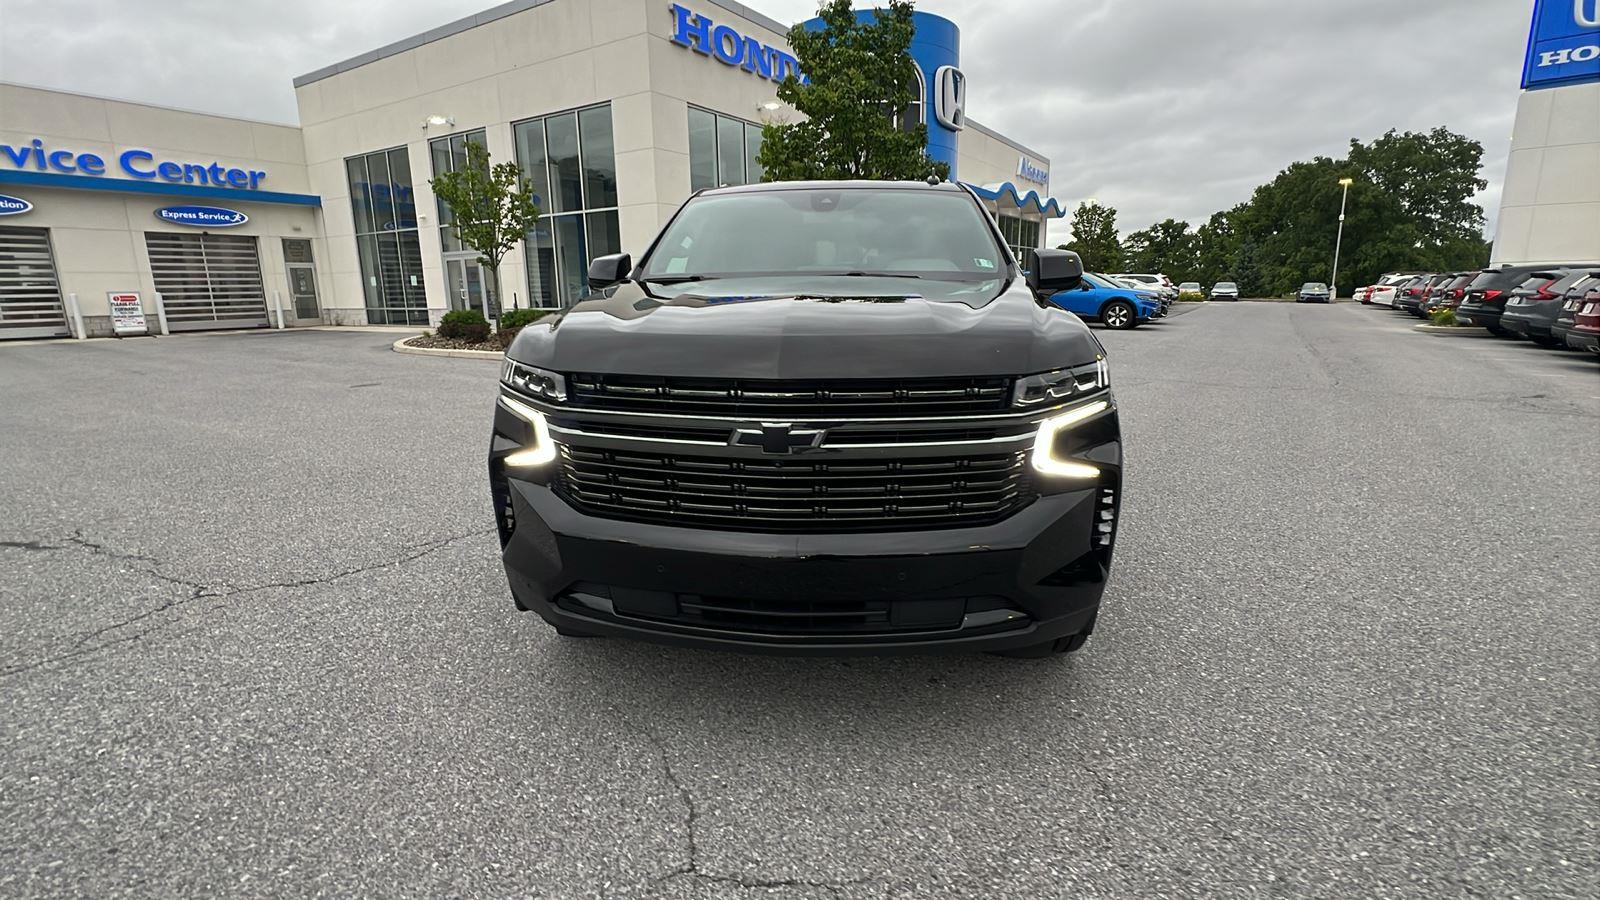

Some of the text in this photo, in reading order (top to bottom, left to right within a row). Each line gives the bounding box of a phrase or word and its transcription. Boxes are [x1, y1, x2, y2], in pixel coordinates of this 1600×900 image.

[1537, 45, 1600, 67] HO
[0, 138, 266, 189] vice Center
[161, 205, 230, 221] Express Service
